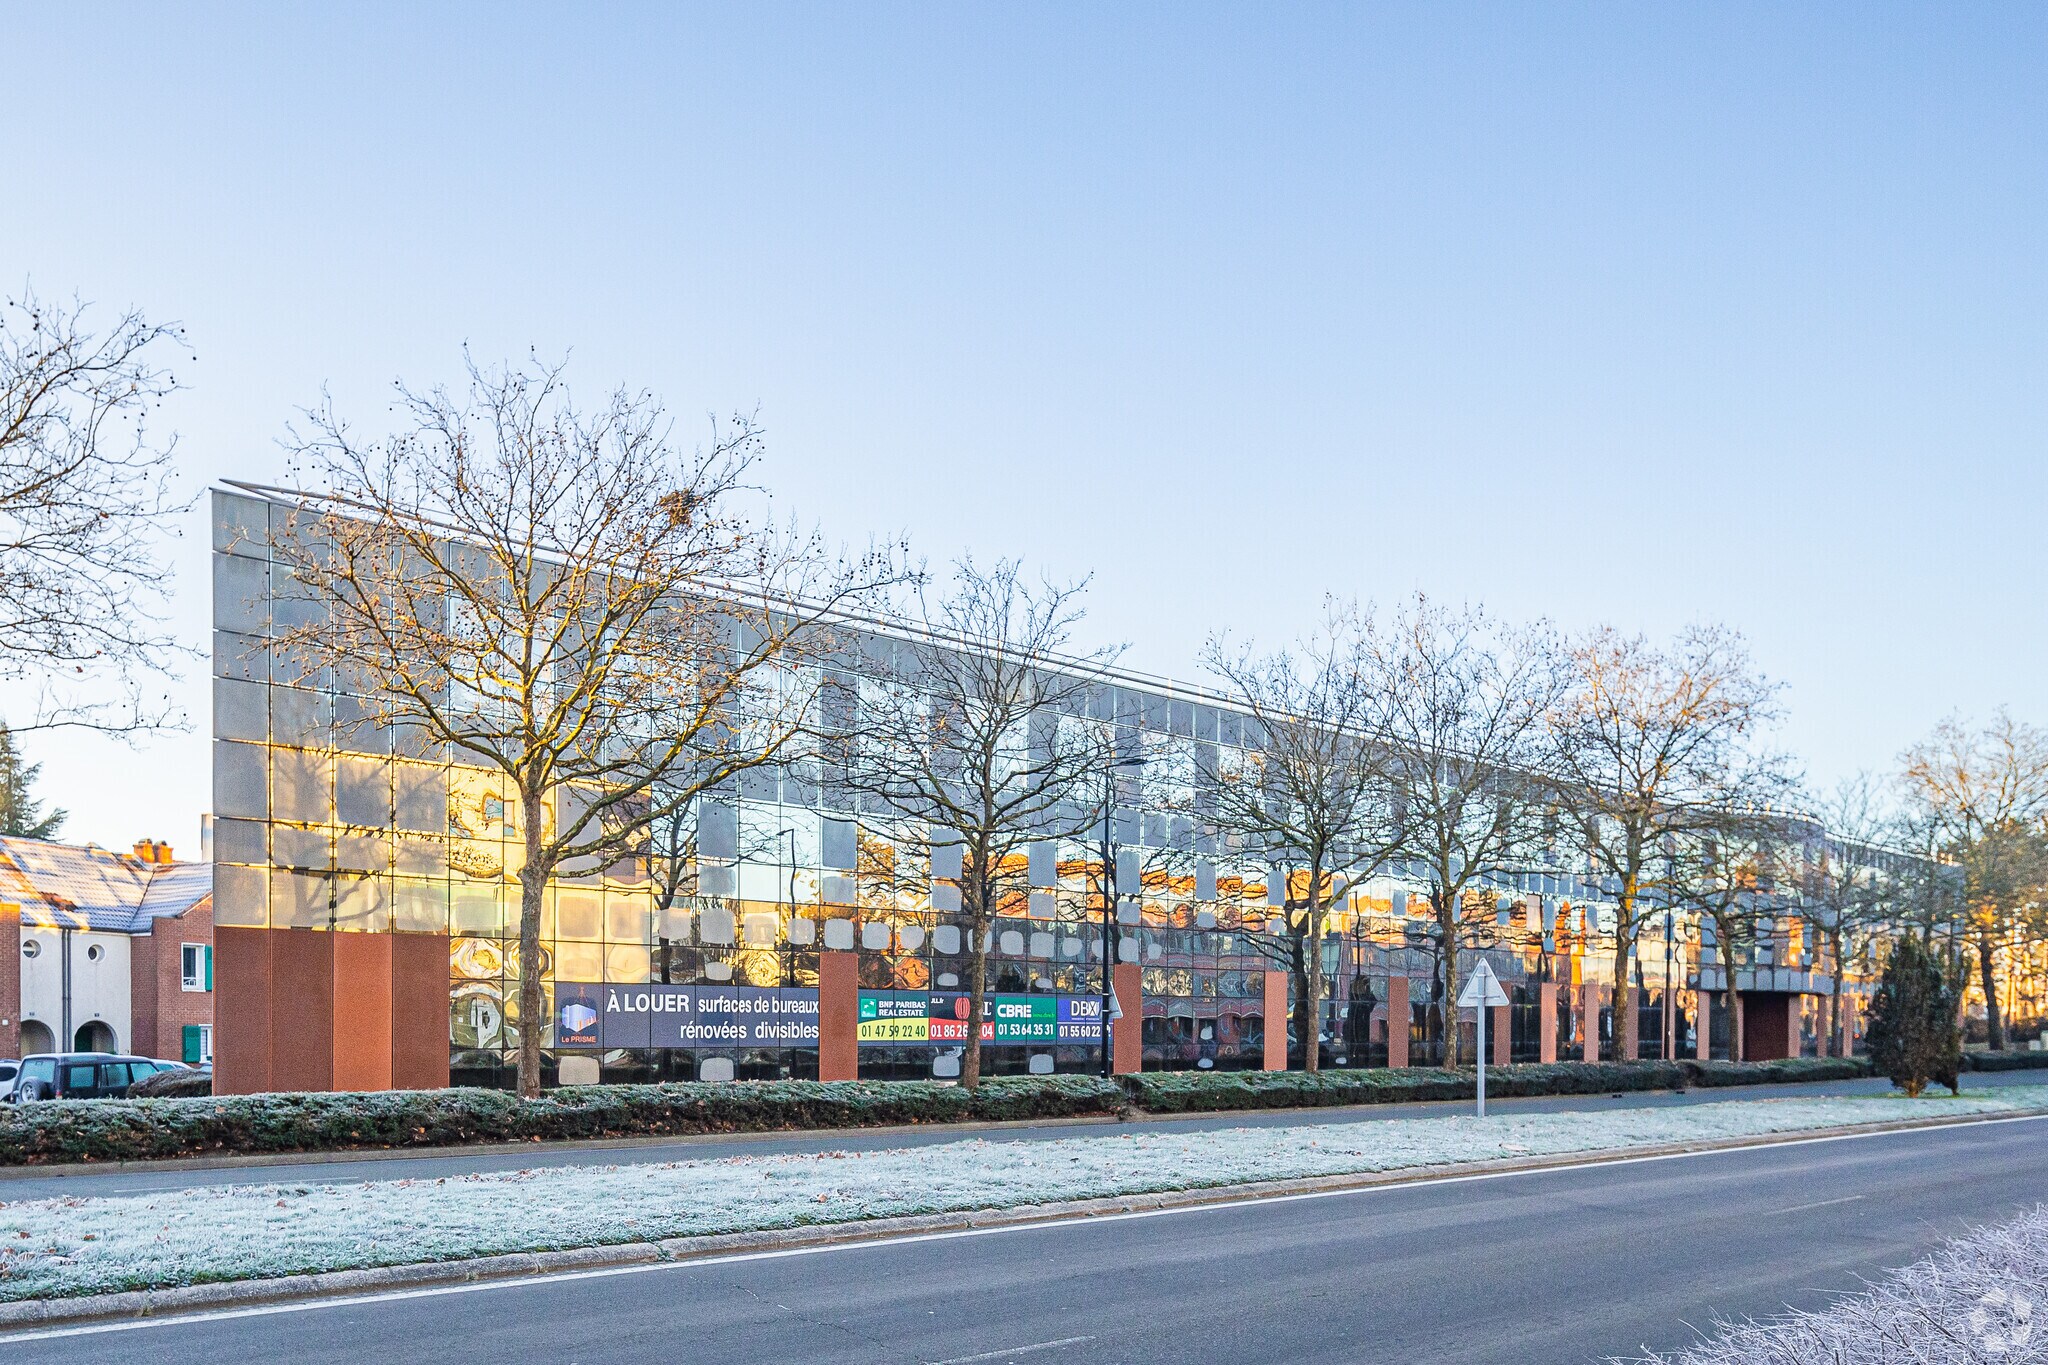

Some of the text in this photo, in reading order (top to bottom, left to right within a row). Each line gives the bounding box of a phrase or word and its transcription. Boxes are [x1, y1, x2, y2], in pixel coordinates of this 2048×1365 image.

[606, 989, 819, 1013] À LOUER surfaces de bureaux
[878, 1000, 927, 1009] BNP PARIBAS
[878, 1009, 924, 1017] REAL ESTATE
[997, 1004, 1032, 1018] CBRE
[680, 1020, 820, 1039] rénovées divisibles
[861, 1025, 926, 1037] 01 47 59 22 40
[930, 1025, 993, 1038] 01 86 26 04
[998, 1023, 1054, 1036] 01 53 64 35 31
[1059, 1025, 1068, 1038] 01
[1070, 1025, 1080, 1038] 55
[1080, 1025, 1091, 1038] 60
[1091, 1025, 1101, 1038] 22
[570, 1035, 597, 1043] PRISME
